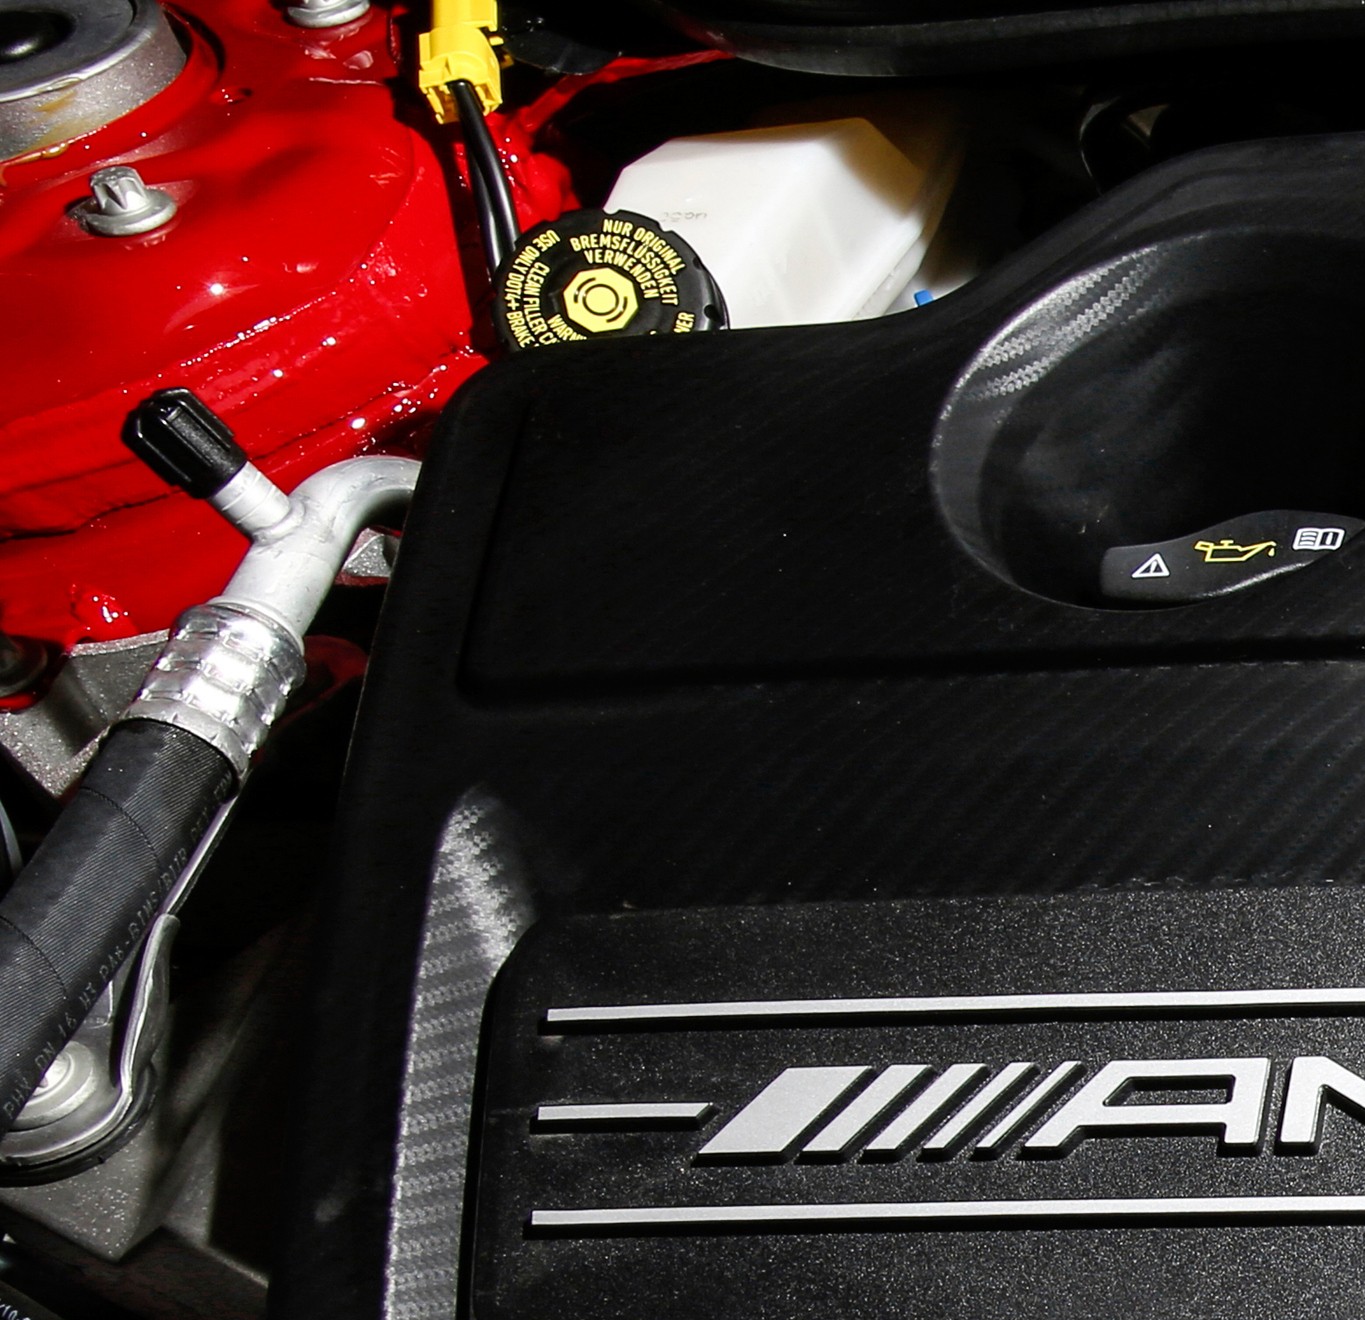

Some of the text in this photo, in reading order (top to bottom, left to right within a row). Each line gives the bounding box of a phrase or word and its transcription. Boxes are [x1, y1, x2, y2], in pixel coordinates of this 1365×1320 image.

[513, 245, 540, 274] ONLY
[532, 229, 561, 252] USE
[603, 219, 686, 275] NUR ORIGINAL
[524, 261, 550, 296] CLEAN
[569, 233, 678, 305] BREMSFLÜSSIGKEIT
[583, 249, 660, 299] VERWENDEN
[506, 310, 536, 349] BRAKE
[523, 297, 548, 336] FILLER
